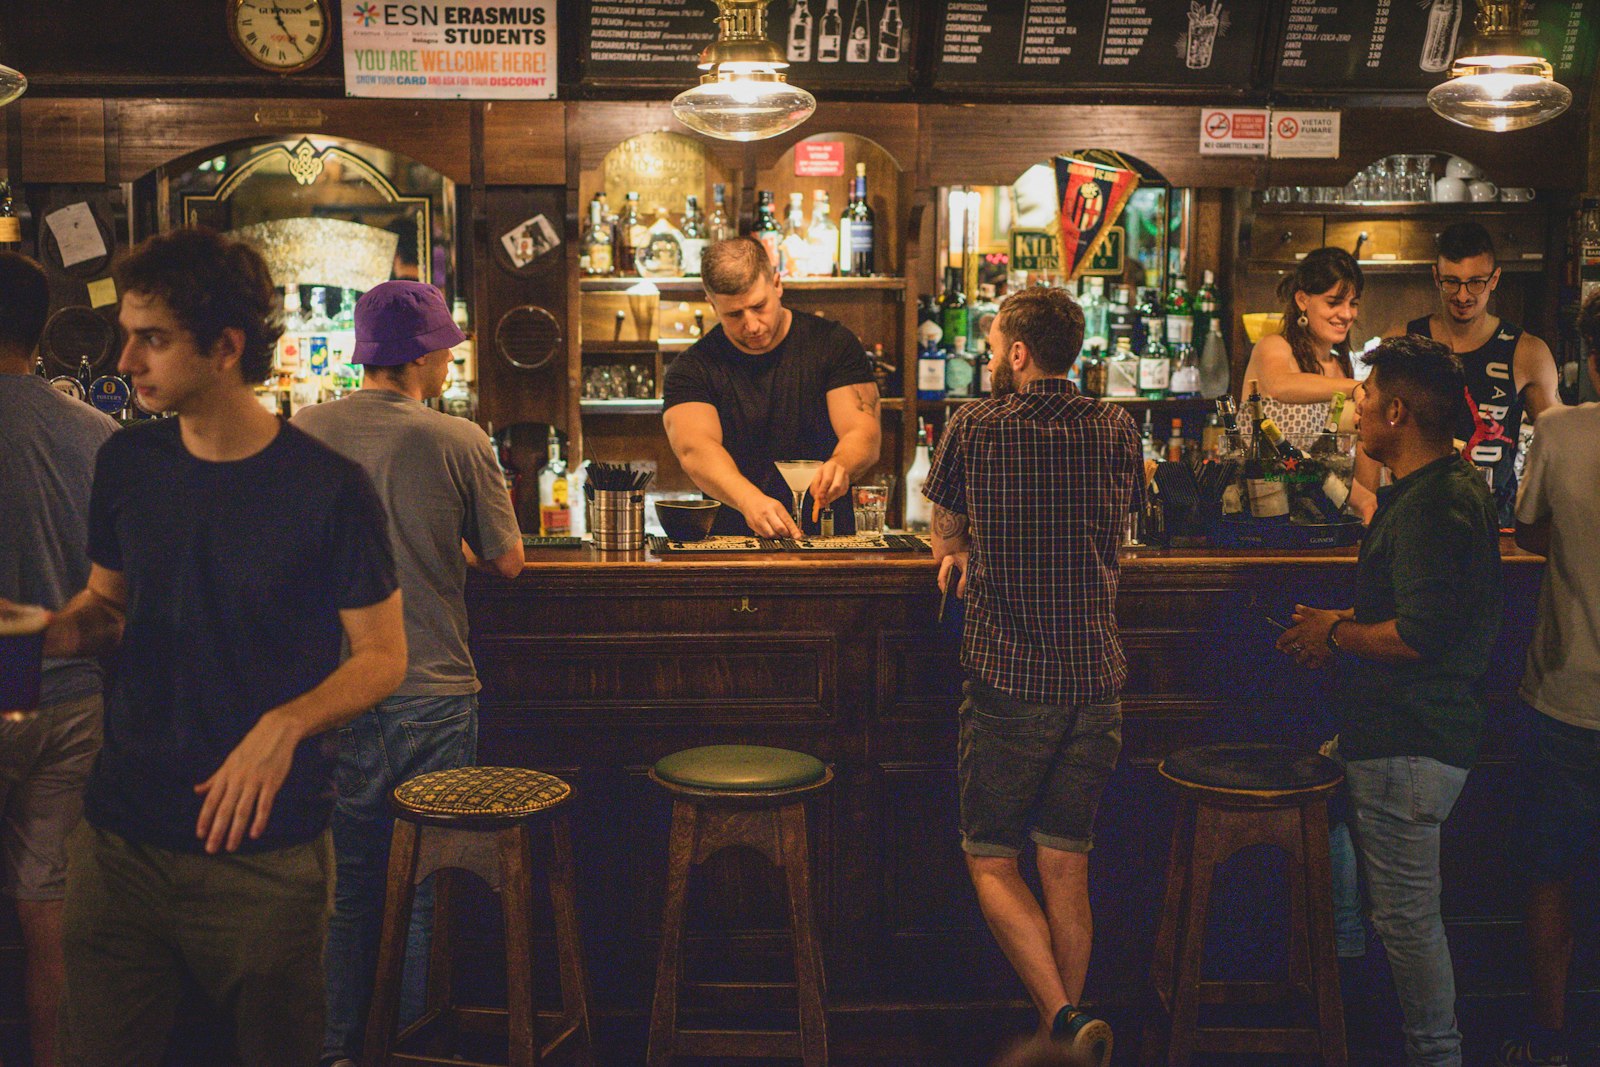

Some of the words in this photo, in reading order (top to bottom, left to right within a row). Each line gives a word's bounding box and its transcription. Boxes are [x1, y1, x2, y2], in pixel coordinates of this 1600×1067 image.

[384, 5, 438, 25] ESN
[445, 7, 545, 25] ERASMUS
[445, 29, 546, 45] STUDENTS
[354, 50, 385, 71] YOU
[390, 50, 418, 71] ARE
[421, 50, 499, 73] WELCOME
[502, 52, 546, 73] HERE!
[637, 53, 650, 61] PILS
[356, 75, 376, 85] SHOW
[378, 76, 395, 85] YOUR
[397, 76, 426, 85] CARD
[428, 76, 442, 86] AND
[443, 77, 456, 86] ASK
[457, 77, 470, 86] FOR
[471, 77, 488, 86] YOUR
[490, 77, 546, 86] DISCOUNT
